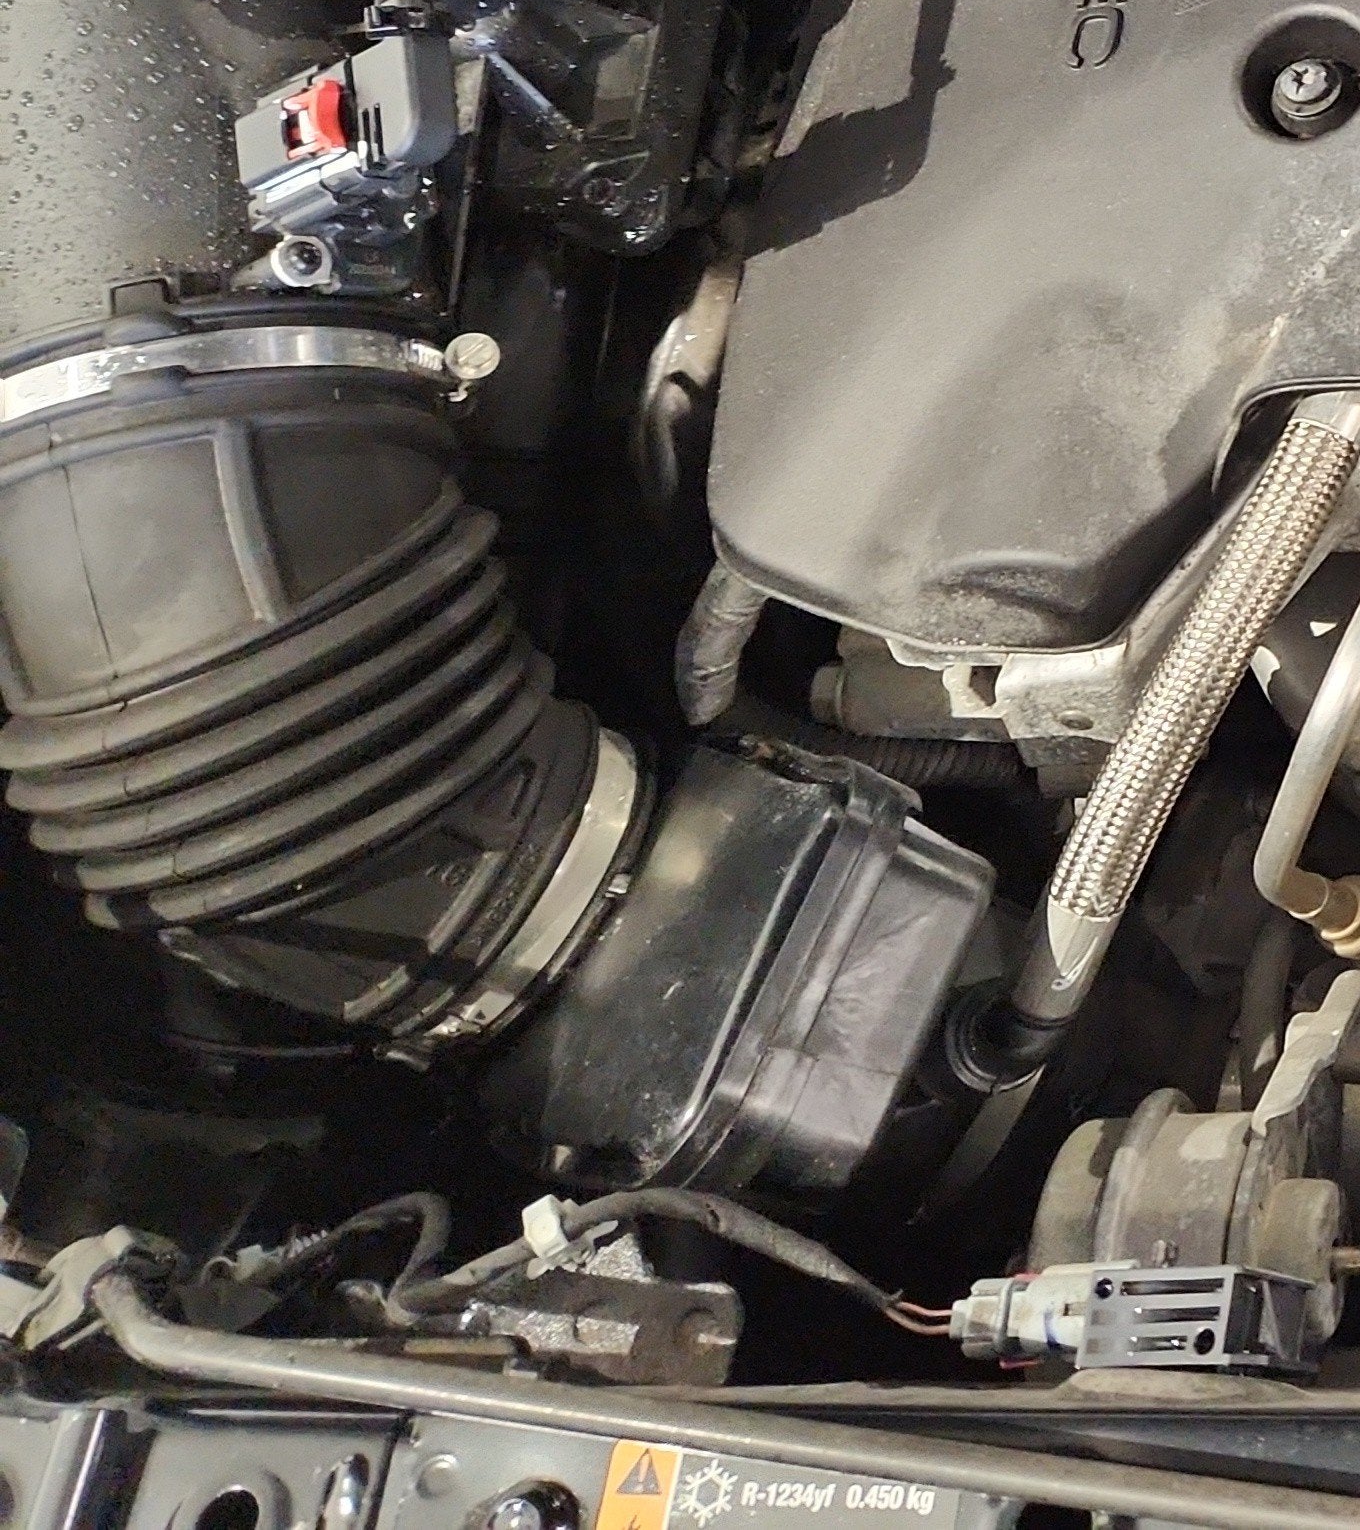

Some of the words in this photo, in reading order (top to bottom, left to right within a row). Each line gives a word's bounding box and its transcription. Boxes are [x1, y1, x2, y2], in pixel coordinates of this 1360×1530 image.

[740, 1481, 837, 1512] R-1234yf
[845, 1483, 904, 1510] 0.450
[905, 1484, 936, 1516] kg
